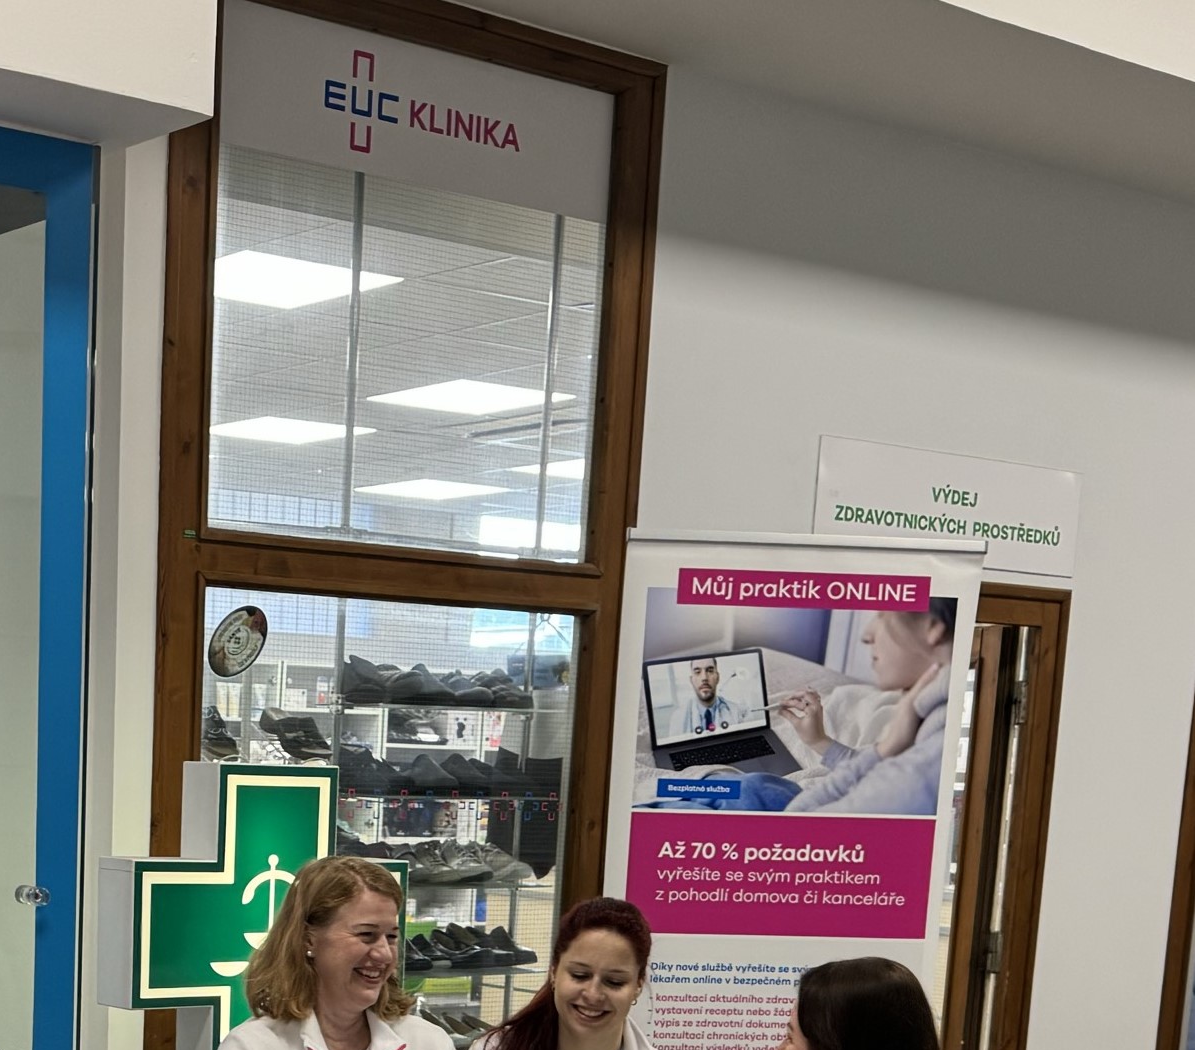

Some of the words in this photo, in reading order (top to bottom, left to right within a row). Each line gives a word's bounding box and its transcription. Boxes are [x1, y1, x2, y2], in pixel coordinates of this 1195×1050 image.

[324, 79, 400, 124] EUC
[409, 99, 520, 152] KLINIKA
[932, 484, 978, 508] VÝDEJ
[835, 505, 967, 535] ZDRAVOTNICKÝCH
[972, 522, 1061, 546] PROSTŘEDKŮ
[692, 576, 733, 600] Můj
[739, 579, 821, 600] praktik
[827, 581, 917, 602] ONLINE
[706, 785, 730, 793] služba
[657, 840, 686, 859] Až
[691, 842, 716, 860] 70
[721, 842, 739, 861] %
[744, 843, 865, 864] požadavků
[657, 867, 721, 883] vyřešíte
[725, 870, 744, 881] se
[748, 869, 790, 885] svým
[795, 869, 880, 886] praktikem
[655, 890, 665, 901] z
[668, 888, 729, 904] pohodlí
[733, 889, 799, 904] domova
[803, 890, 818, 905] či
[822, 891, 905, 907] kanceláře
[651, 962, 673, 973] Díky
[676, 962, 700, 972] nové
[702, 962, 733, 973] službě
[736, 963, 776, 974] vyřešíte
[779, 966, 789, 974] se
[650, 974, 691, 984] lékařem
[693, 975, 722, 985] online
[725, 977, 731, 985] v
[733, 976, 791, 986] bezpečném
[656, 993, 707, 1003] konzultaci
[709, 994, 764, 1004] aktuálního
[655, 1006, 703, 1016] vystavení
[705, 1008, 743, 1017] receptu
[746, 1008, 771, 1016] nebo
[654, 1019, 680, 1029] výpis
[696, 1019, 743, 1028] zdravotní
[653, 1031, 705, 1040] konzultaci
[707, 1032, 768, 1042] chronických
